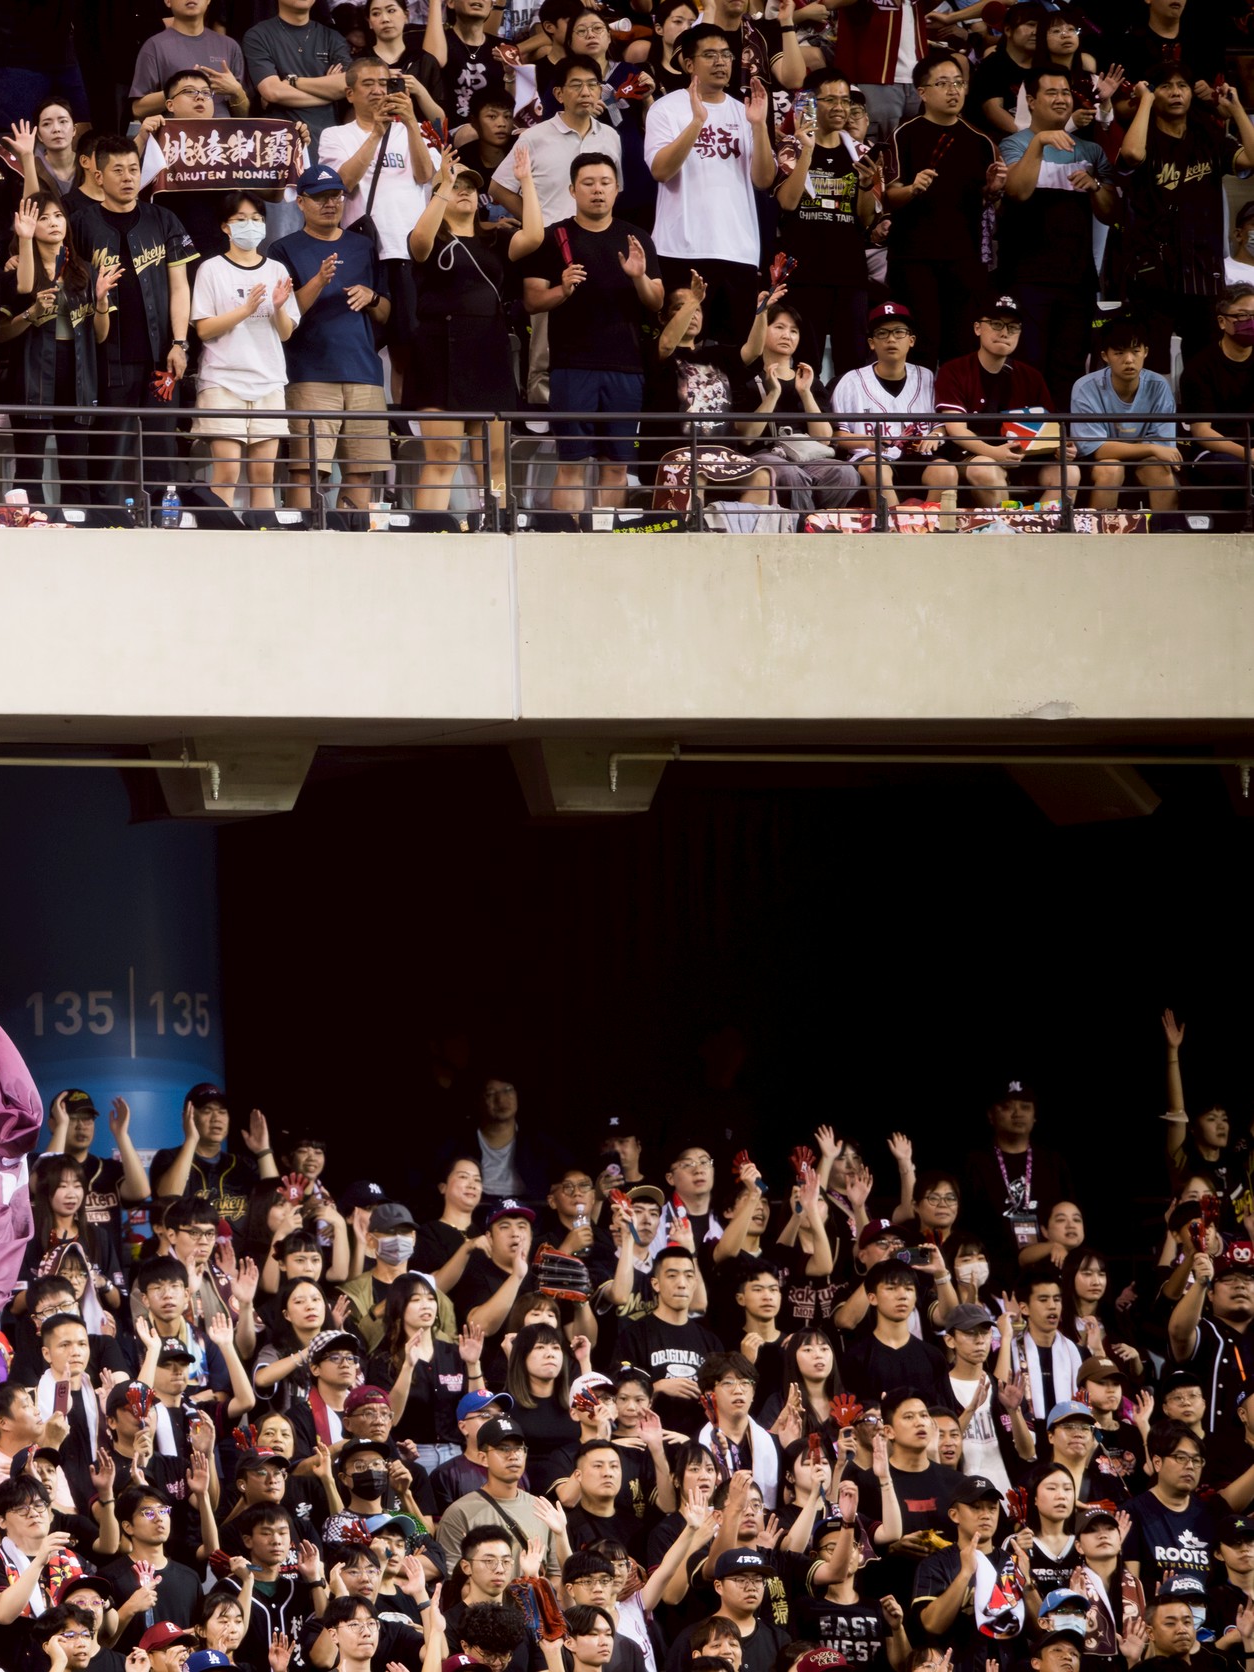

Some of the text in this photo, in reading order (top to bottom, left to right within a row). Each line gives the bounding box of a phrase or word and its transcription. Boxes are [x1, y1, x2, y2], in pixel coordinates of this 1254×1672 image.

[621, 84, 633, 95] R
[166, 169, 290, 182] RAKUTEN MONKEYS
[884, 304, 895, 315] R
[26, 990, 211, 1038] 135 135
[290, 1187, 299, 1200] R
[880, 1218, 891, 1229] R
[1155, 1545, 1209, 1565] ROOTS
[165, 1622, 180, 1633] R
[819, 1616, 878, 1638] EAST
[206, 1651, 220, 1664] LA
[823, 1640, 882, 1663] WEST
[458, 1655, 471, 1666] R
